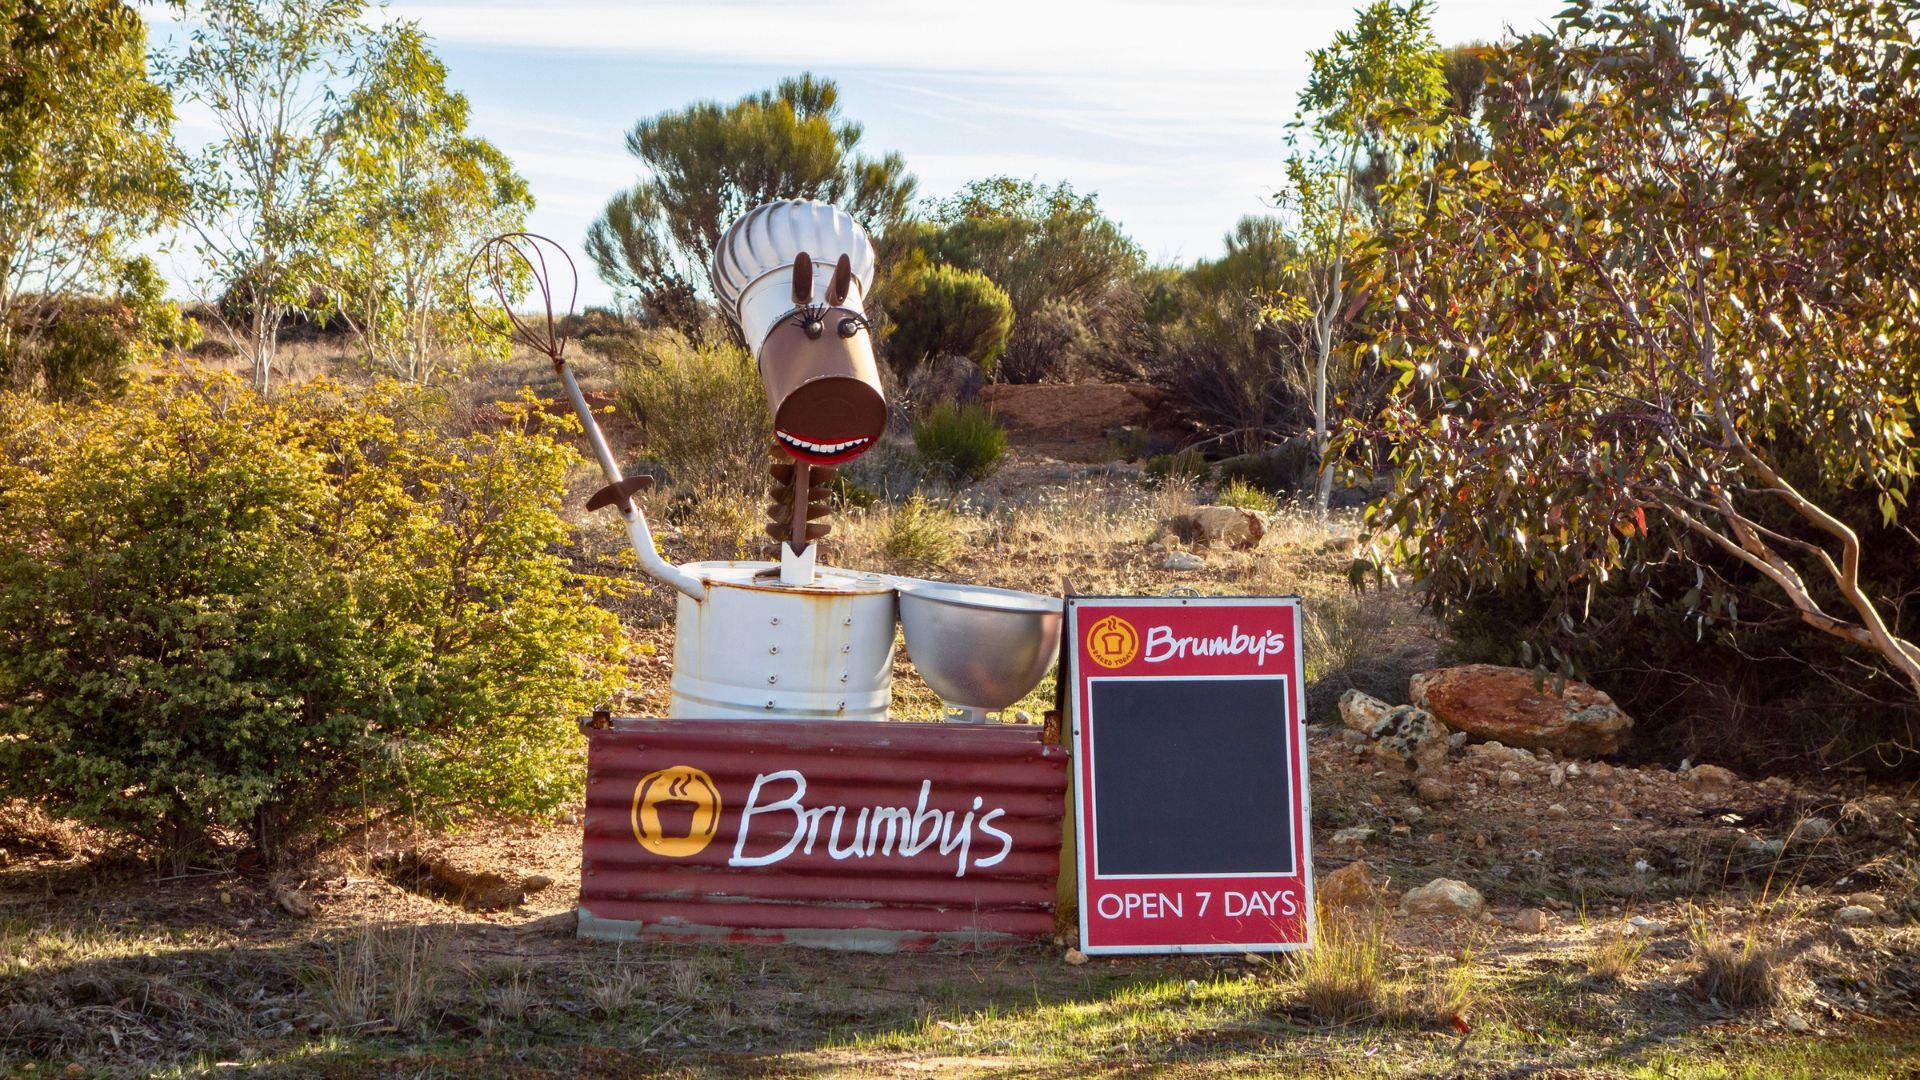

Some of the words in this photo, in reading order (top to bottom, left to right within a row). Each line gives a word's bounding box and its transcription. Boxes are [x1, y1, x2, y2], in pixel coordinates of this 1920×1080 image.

[1144, 625, 1285, 666] Brumby's
[728, 769, 1012, 877] Brumby's
[1097, 892, 1183, 919] OPEN
[1195, 891, 1211, 917] 7
[1224, 890, 1297, 917] DAYS
